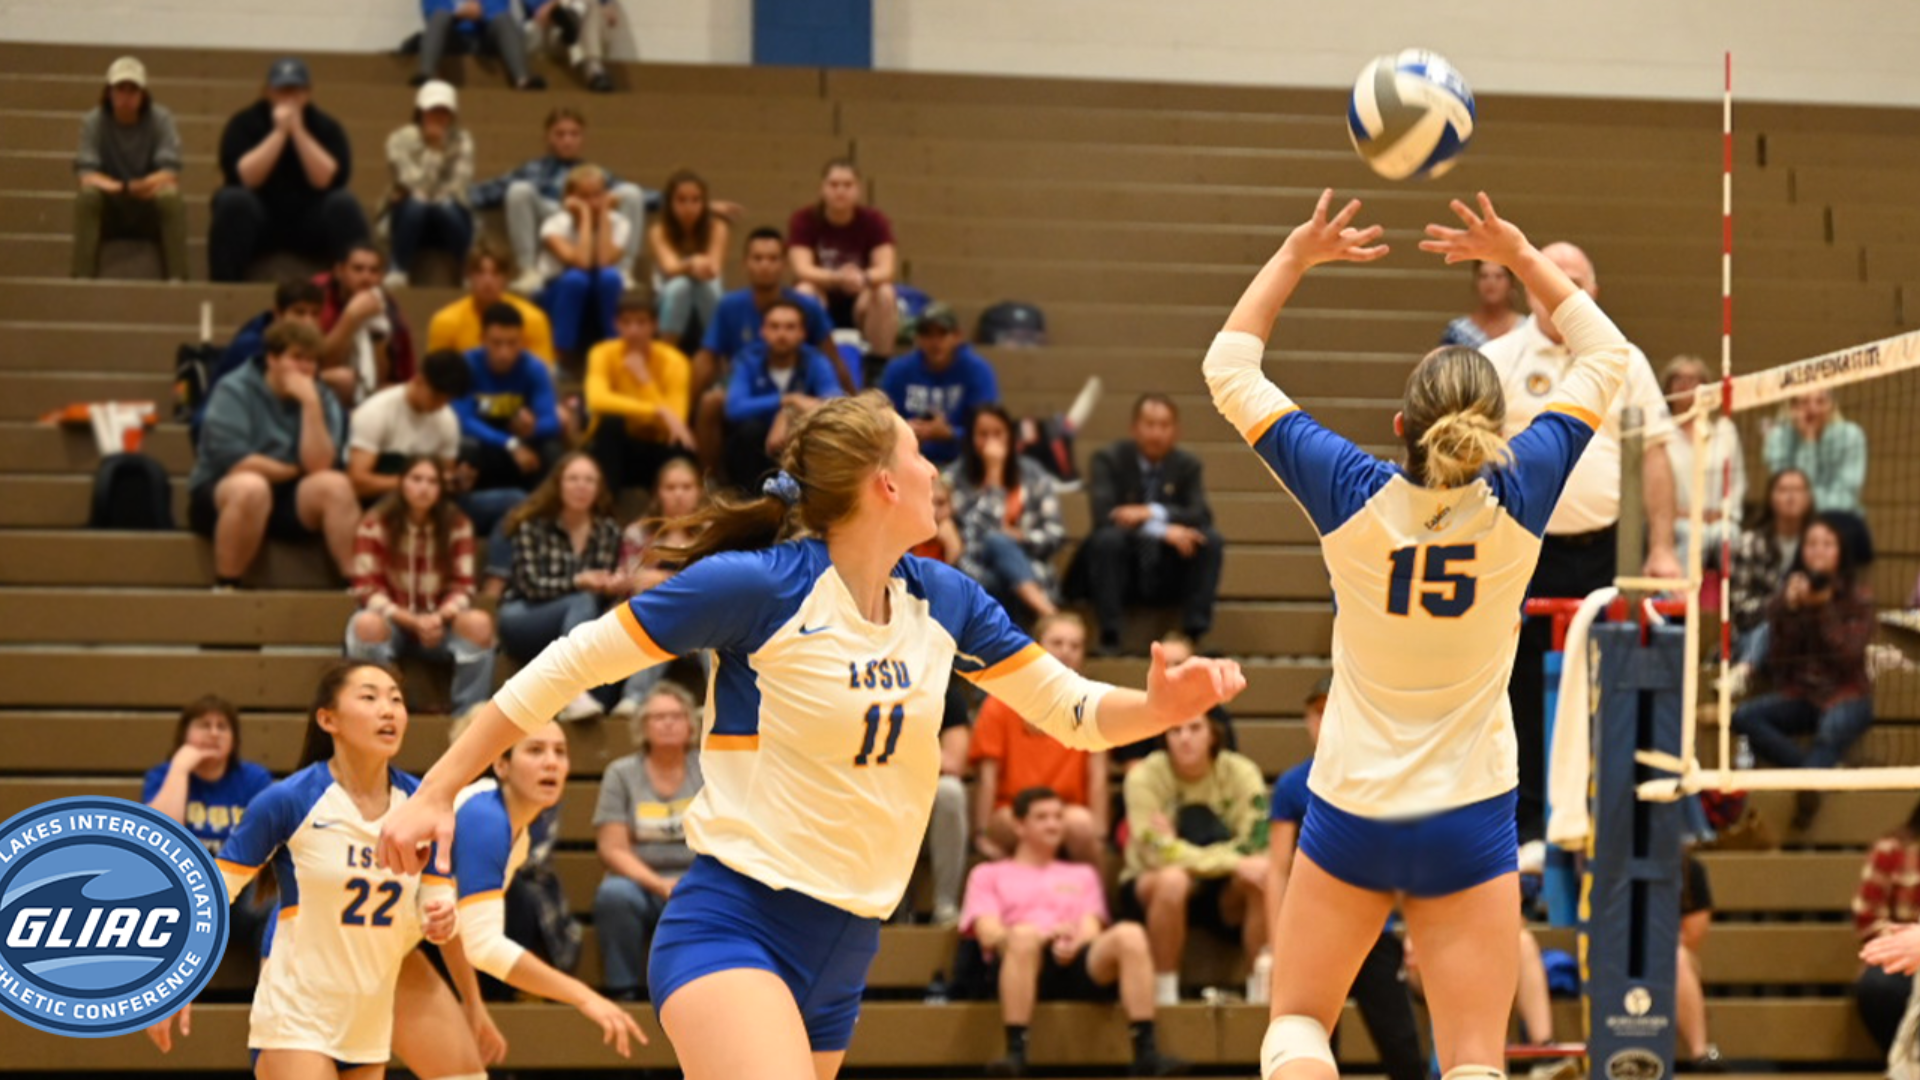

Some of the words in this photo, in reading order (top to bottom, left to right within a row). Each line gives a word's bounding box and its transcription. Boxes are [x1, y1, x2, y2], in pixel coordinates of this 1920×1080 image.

[1386, 543, 1477, 618] 15
[849, 659, 911, 689] LSSU
[854, 703, 904, 765] 11
[347, 845, 379, 869] LS
[341, 877, 403, 926] 22
